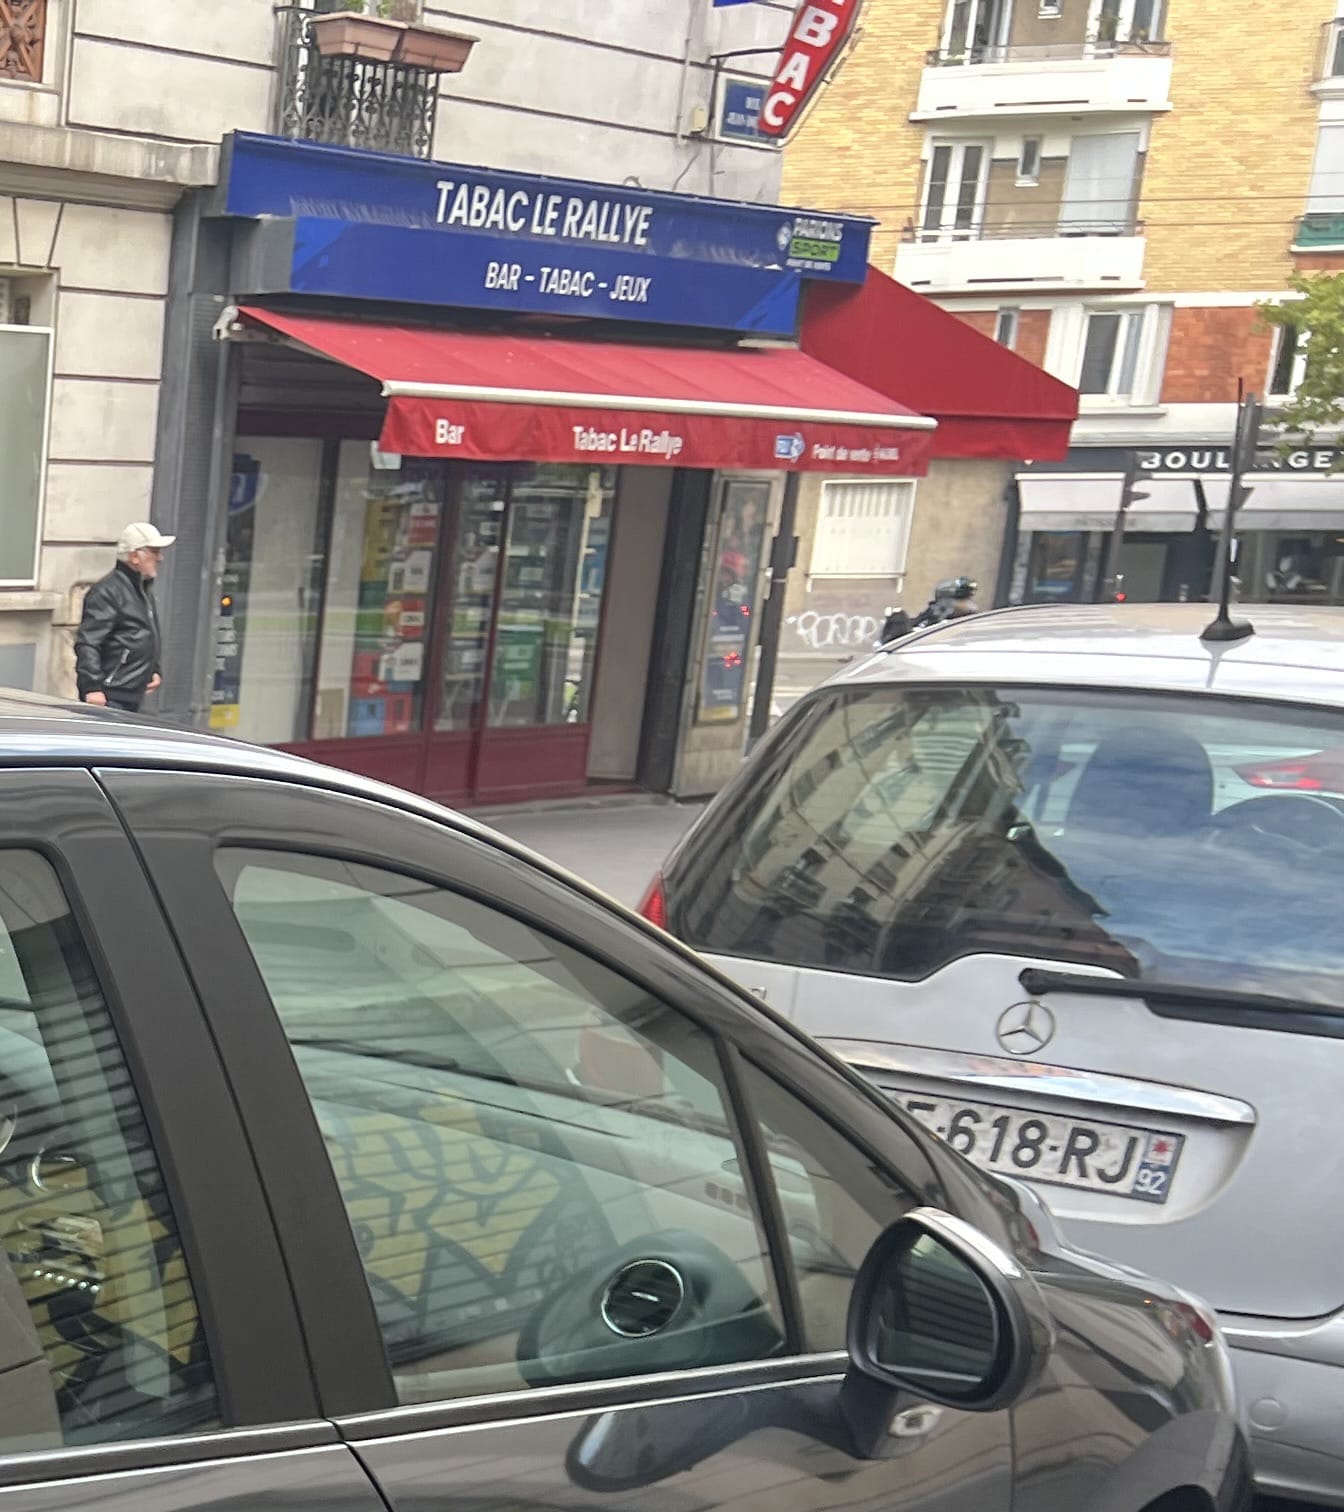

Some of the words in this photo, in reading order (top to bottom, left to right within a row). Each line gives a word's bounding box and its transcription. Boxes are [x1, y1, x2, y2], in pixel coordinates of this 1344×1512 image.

[764, 0, 846, 126] BAC
[436, 181, 529, 232] TABAC
[531, 193, 562, 236] LE
[563, 197, 653, 246] RALLYE
[485, 262, 521, 290] BAR
[538, 267, 595, 297] TABAC
[609, 274, 652, 302] JEUX
[435, 418, 464, 445] Bar
[573, 426, 618, 452] Tabac
[620, 428, 638, 452] Le
[638, 429, 683, 460] Rallye
[1139, 450, 1344, 469] BOULGE
[907, 1101, 1140, 1184] -618-RJ
[1135, 1168, 1167, 1195] 92
